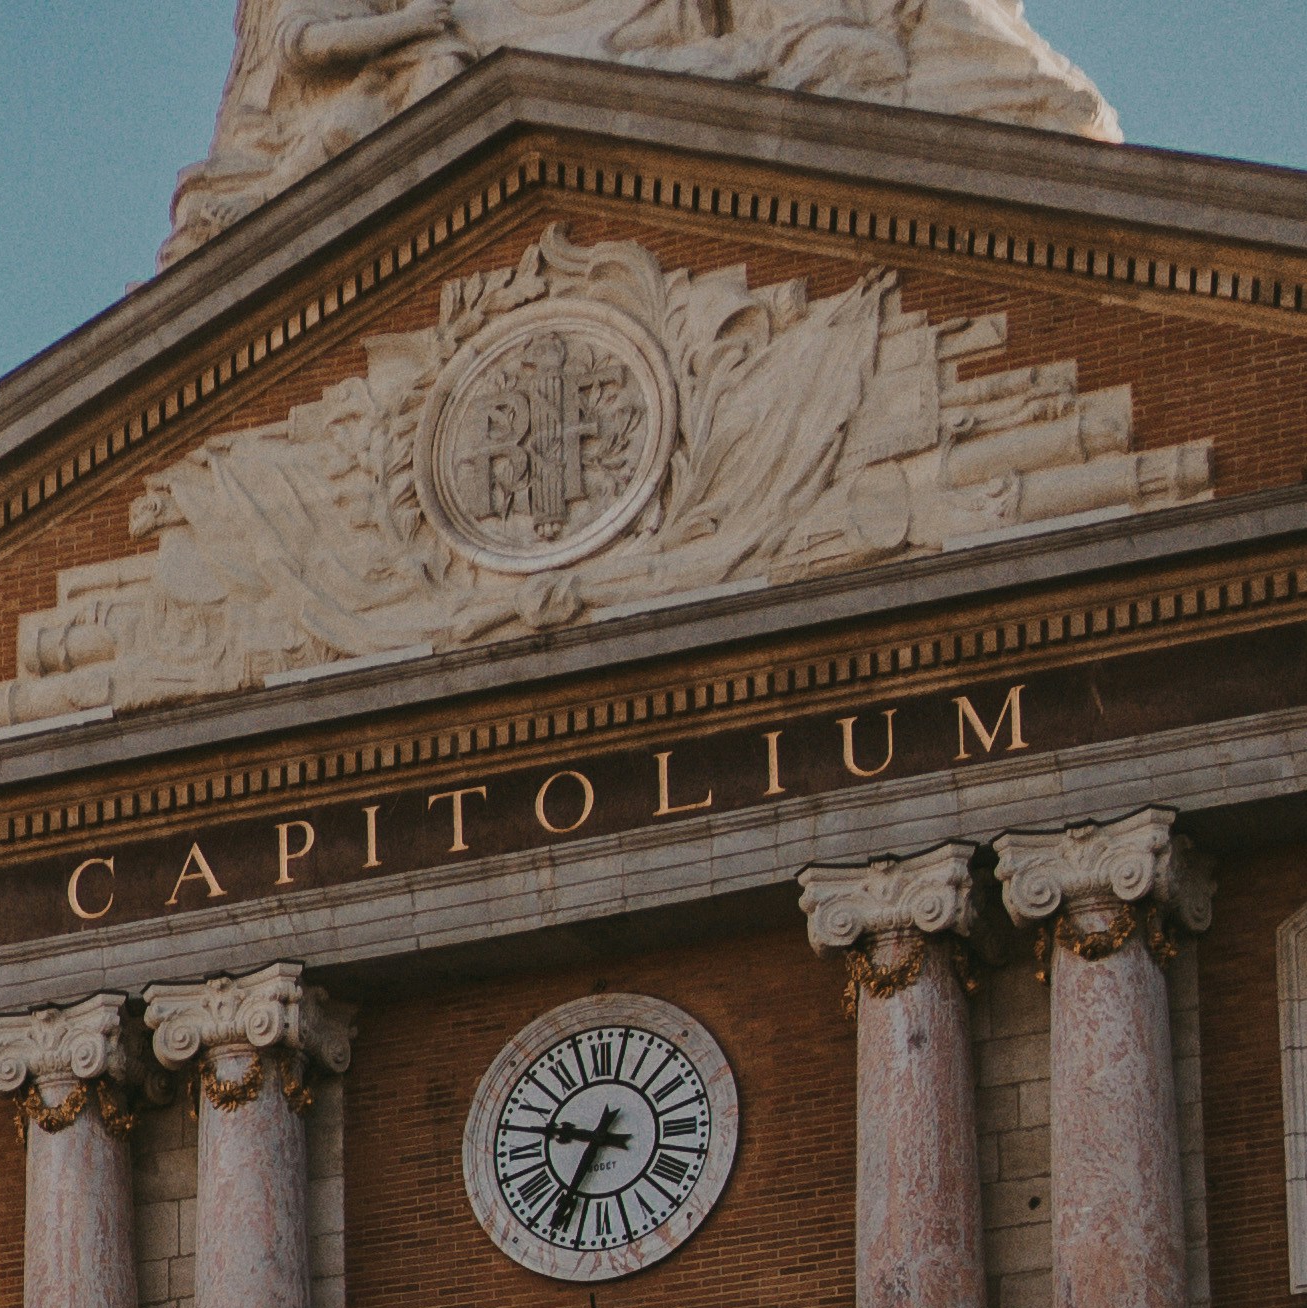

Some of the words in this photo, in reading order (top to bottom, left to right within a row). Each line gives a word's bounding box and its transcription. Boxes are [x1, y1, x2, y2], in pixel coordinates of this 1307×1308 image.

[67, 685, 1029, 918] CAPITOLIUM
[590, 1041, 612, 1079] XII
[630, 1047, 651, 1080] I
[548, 1059, 577, 1094] XI
[652, 1074, 685, 1104] II
[519, 1098, 552, 1121] X
[663, 1117, 697, 1138] III
[509, 1140, 542, 1162] IX
[596, 1202, 612, 1236] VI
[634, 1190, 655, 1219] V
